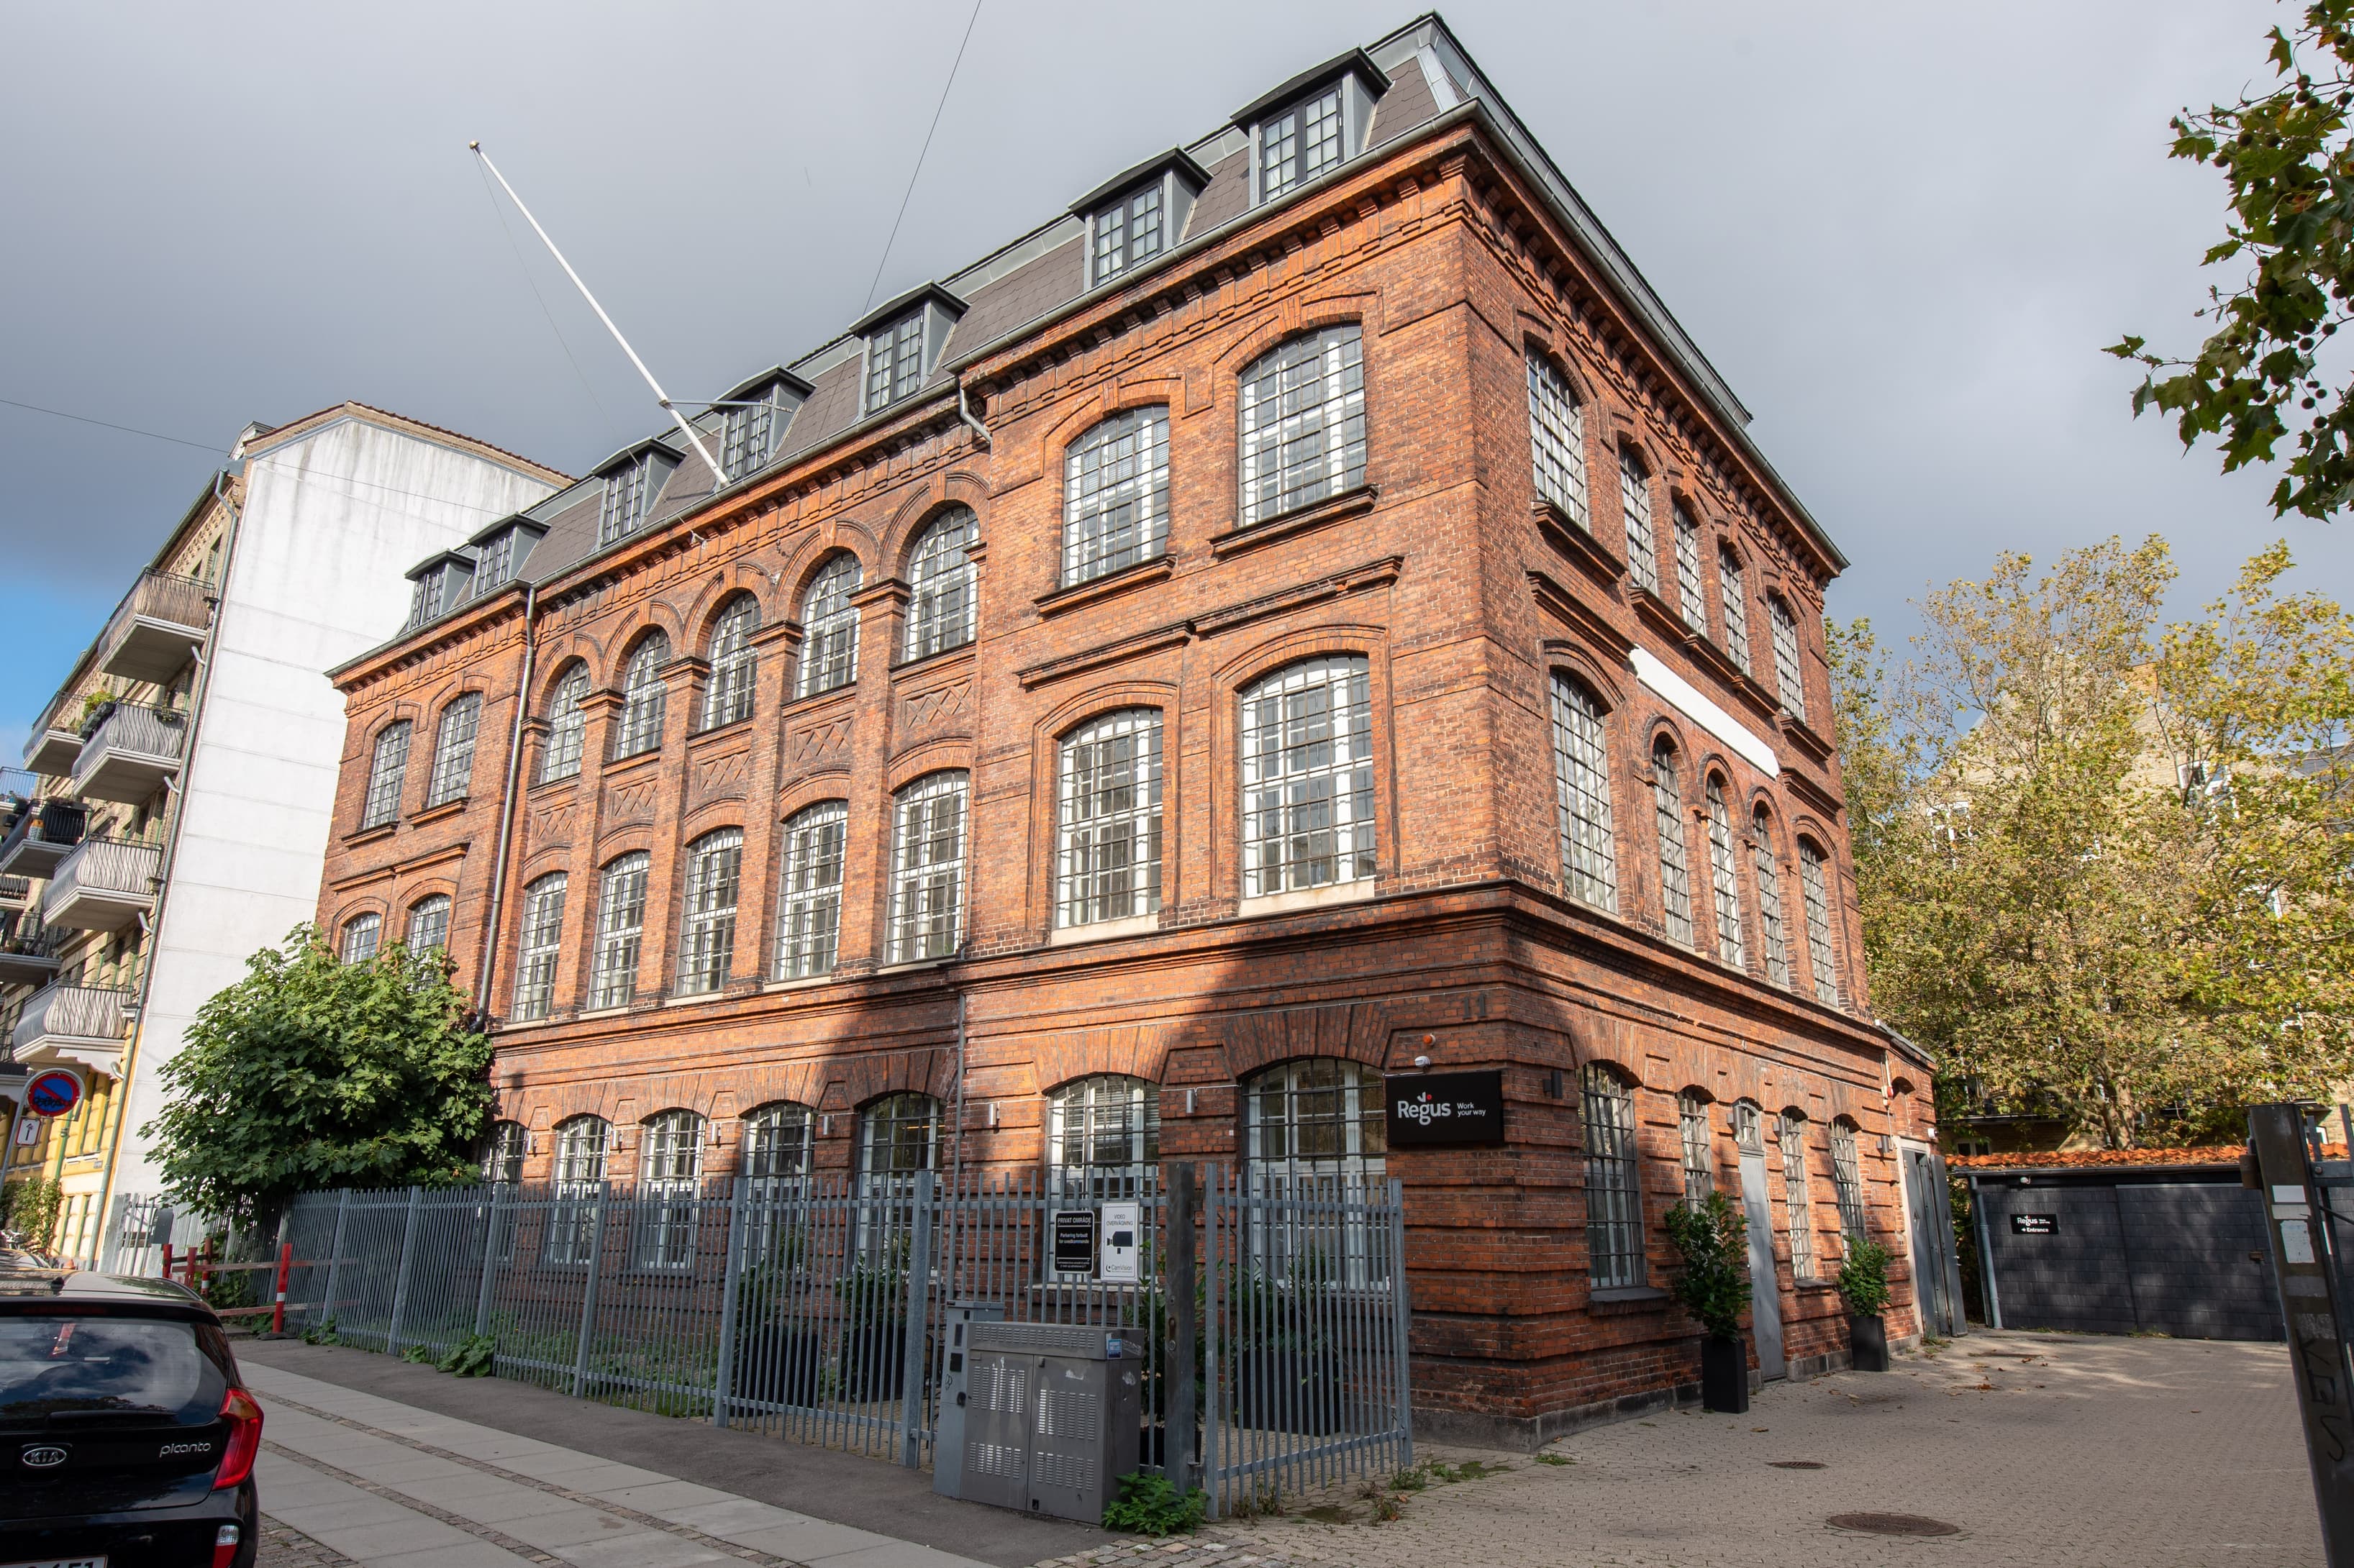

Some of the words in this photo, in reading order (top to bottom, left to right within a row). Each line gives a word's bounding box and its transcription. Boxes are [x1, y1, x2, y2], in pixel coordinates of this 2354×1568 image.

[1398, 1100, 1451, 1126] Regus
[2017, 1217, 2038, 1226] Regus
[159, 1441, 211, 1458] picanto
[30, 1451, 59, 1463] KIA
